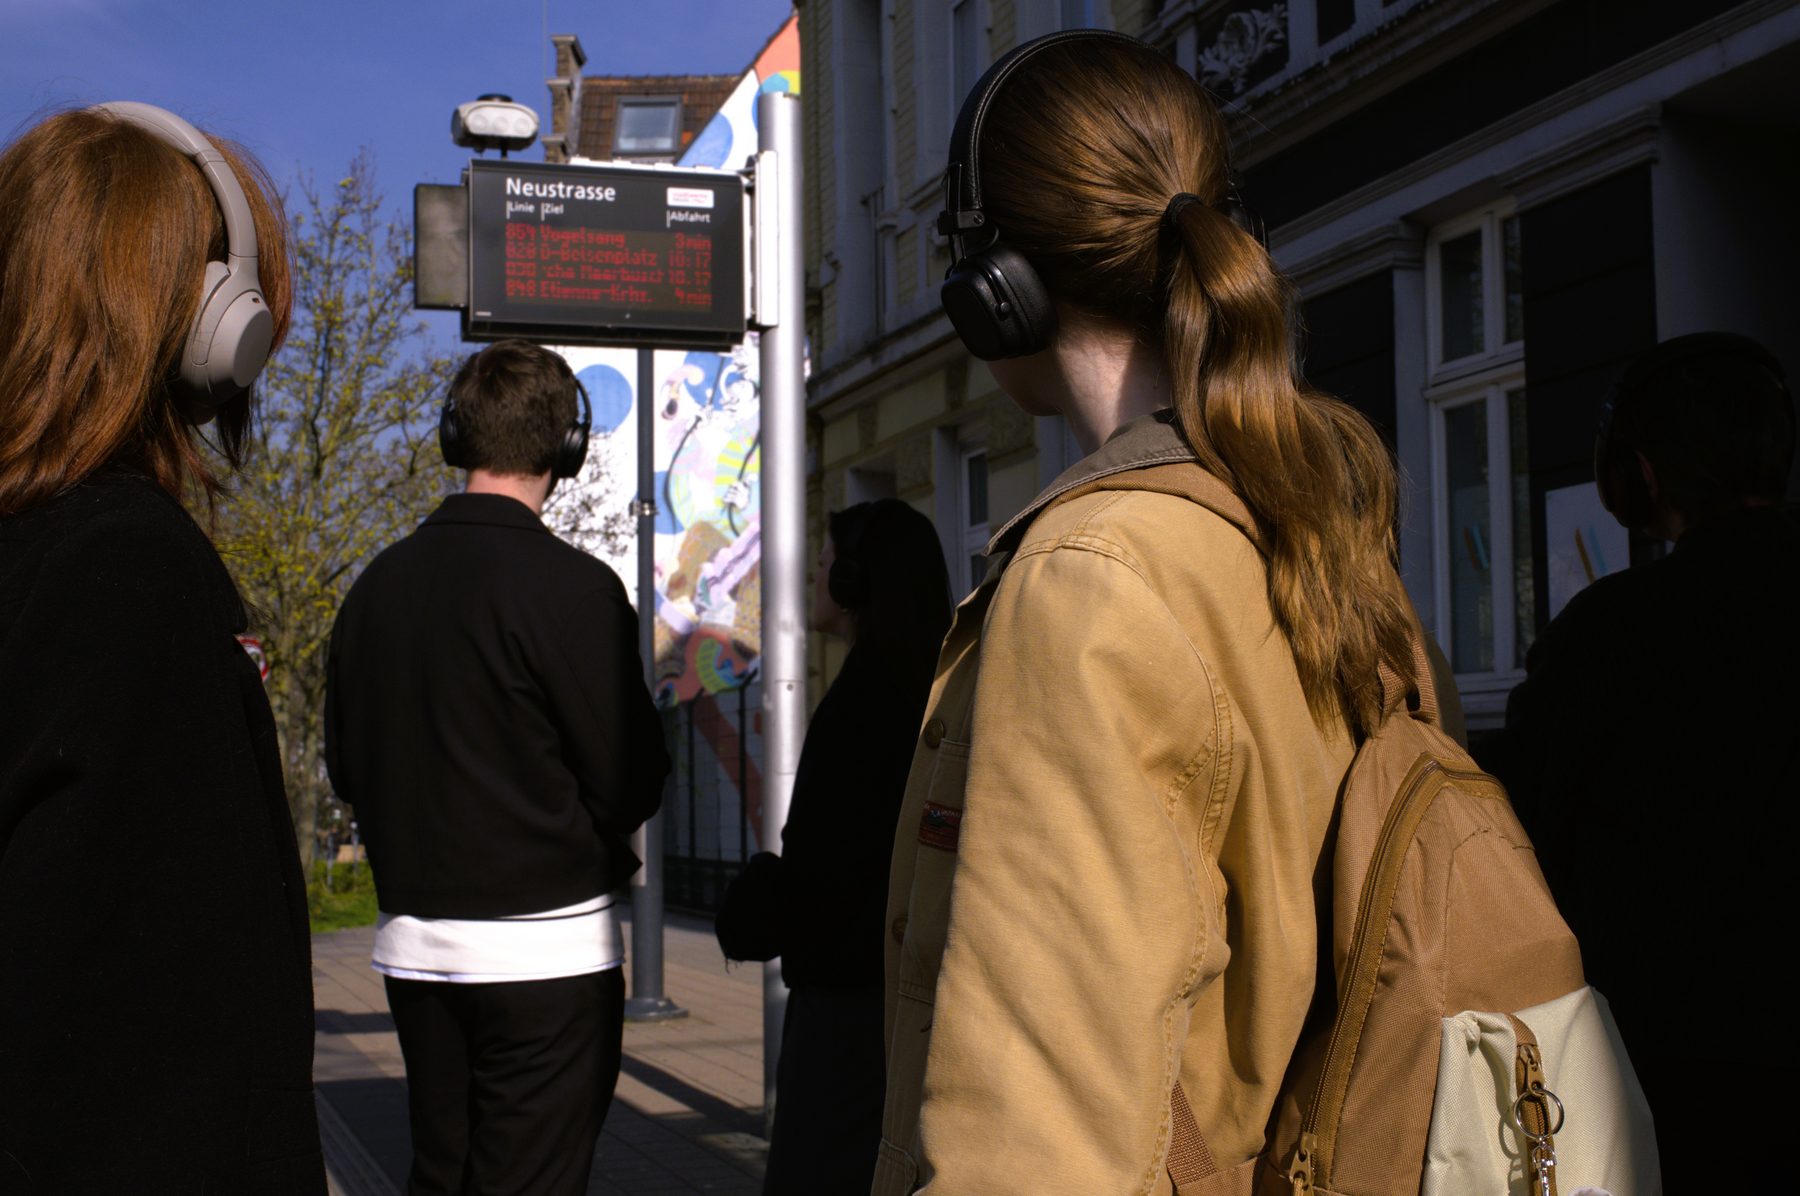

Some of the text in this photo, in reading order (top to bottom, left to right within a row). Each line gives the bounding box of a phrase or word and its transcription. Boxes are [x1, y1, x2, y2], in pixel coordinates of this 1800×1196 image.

[506, 177, 616, 201] Neustrasse
[510, 202, 710, 223] Linie Ziel Abfahrt
[506, 223, 536, 241] 854
[540, 224, 625, 248] Vogelsang
[506, 279, 536, 296] 848
